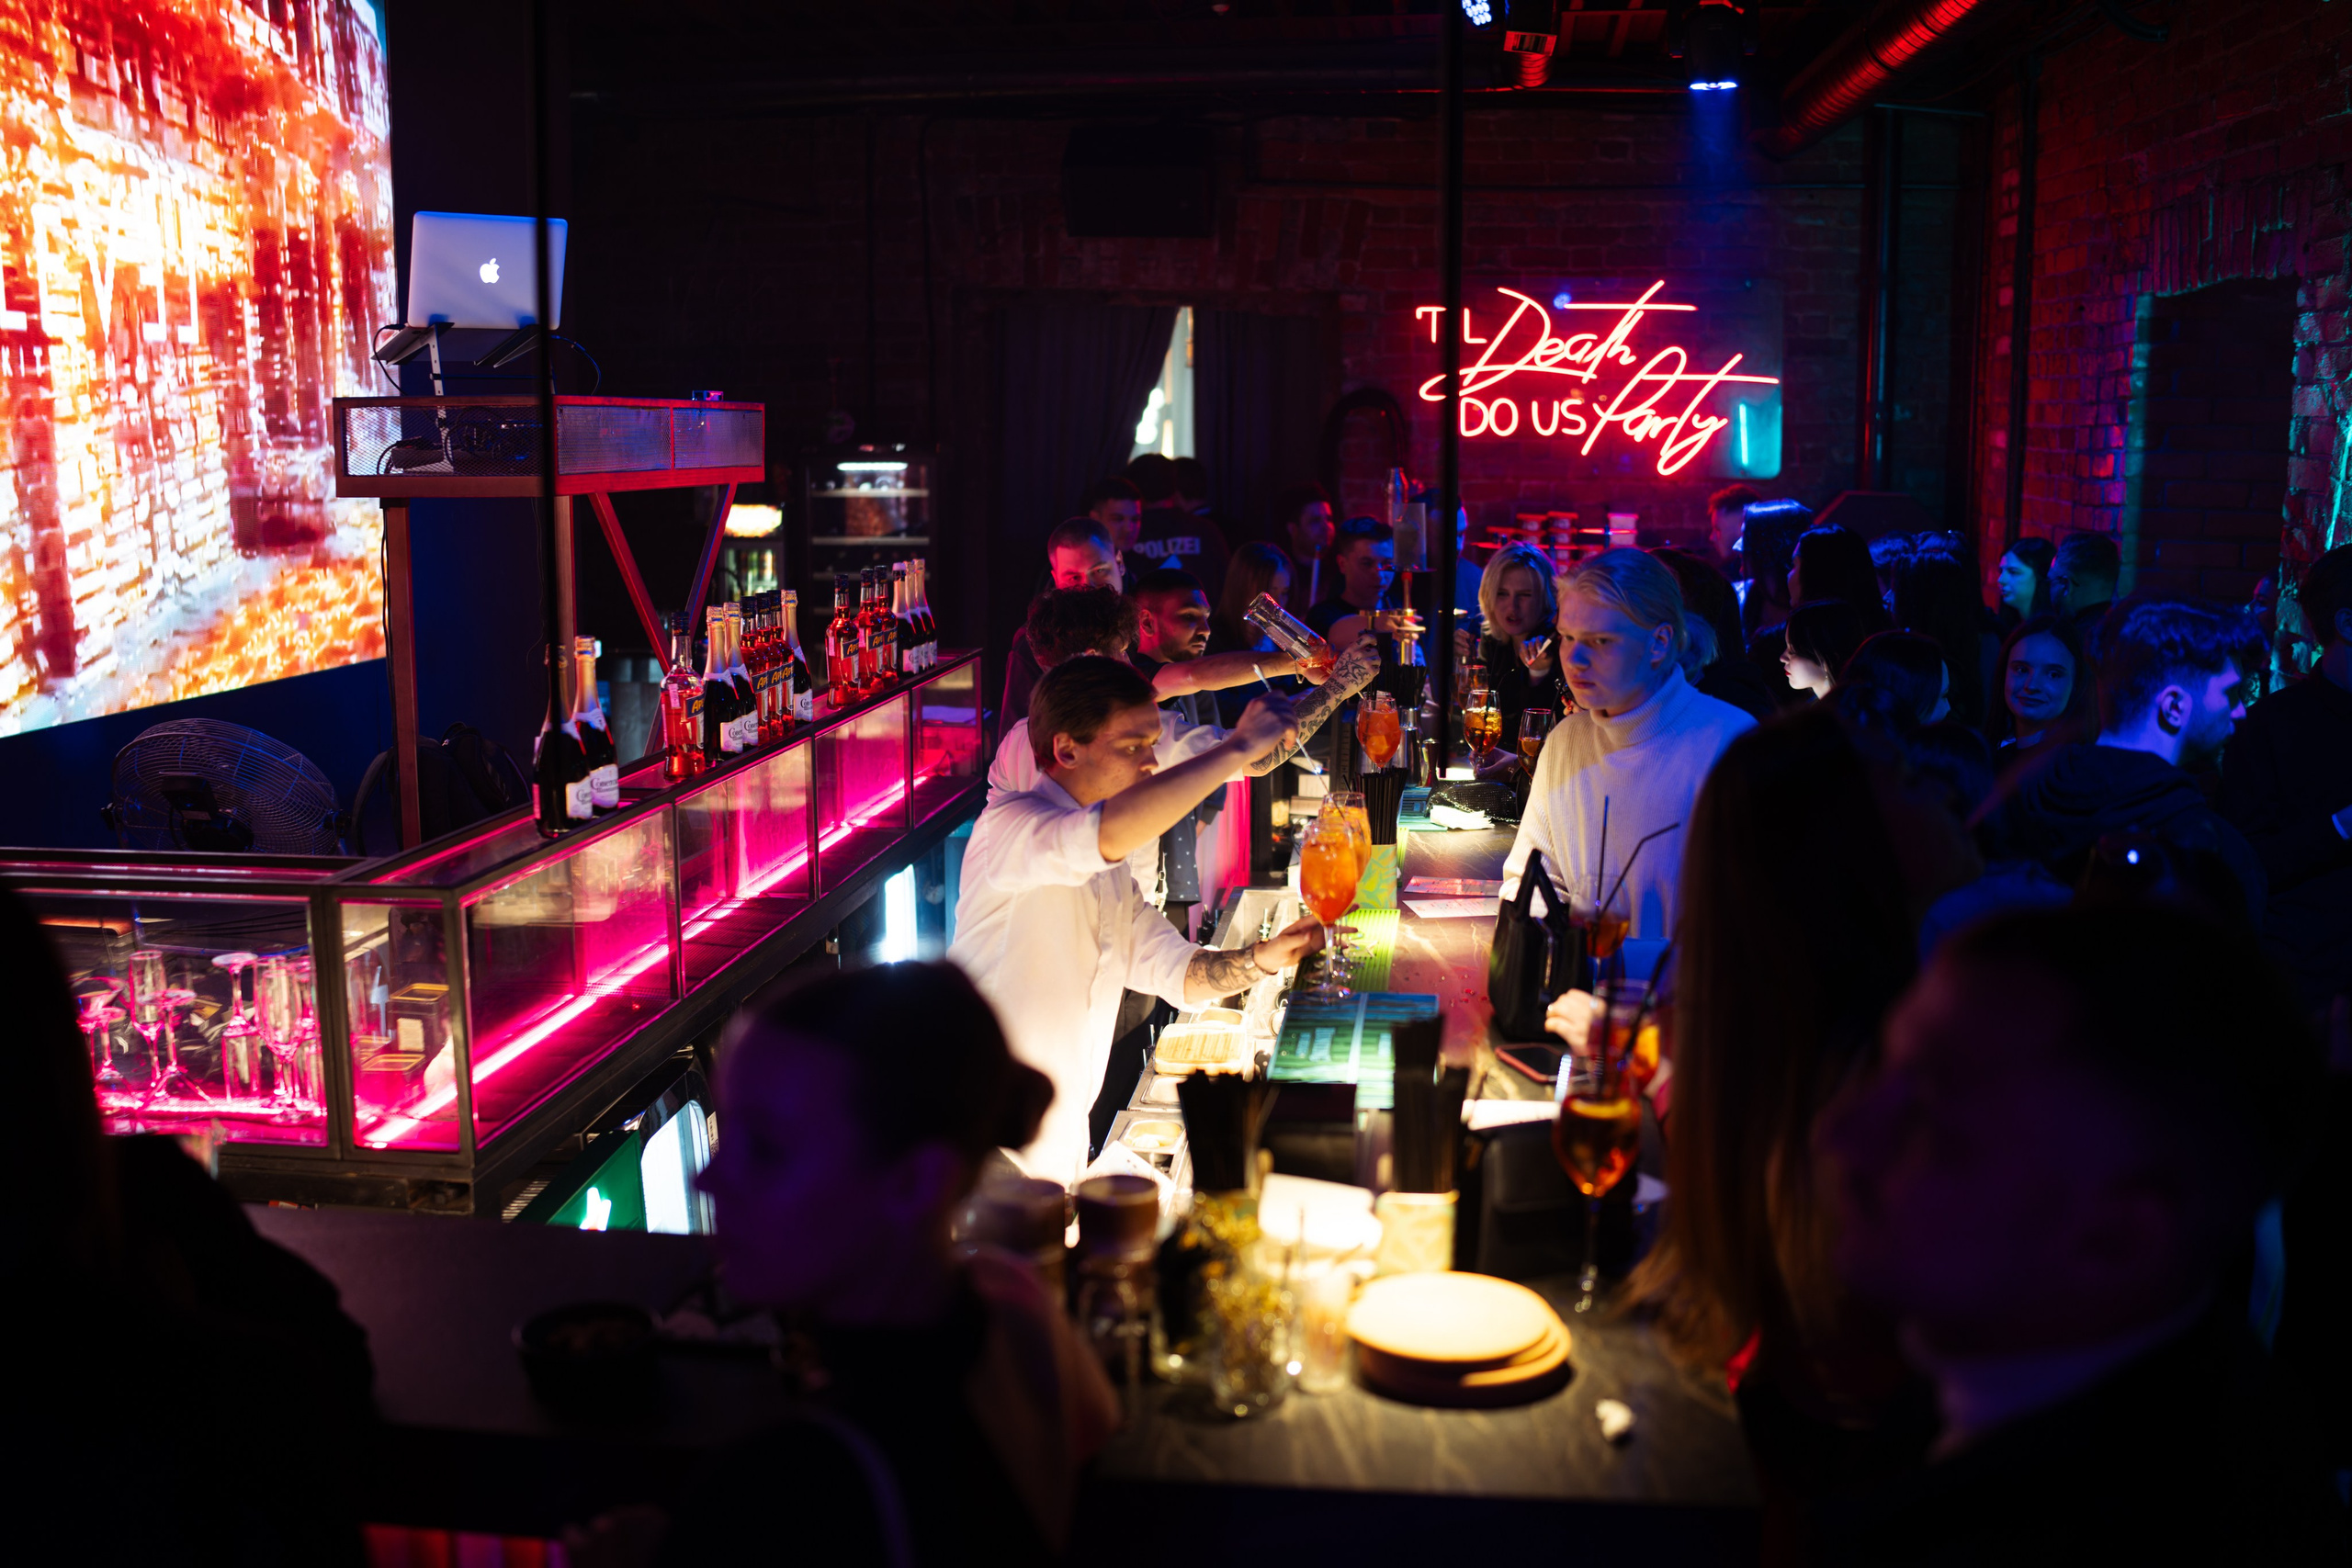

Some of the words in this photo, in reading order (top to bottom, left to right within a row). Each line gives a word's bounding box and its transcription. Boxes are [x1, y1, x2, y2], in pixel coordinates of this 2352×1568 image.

[1419, 279, 1699, 401] Death
[1459, 396, 1520, 437] DO
[1531, 397, 1588, 437] US
[1581, 345, 1780, 476] Party
[1132, 536, 1201, 559] POLIZEI
